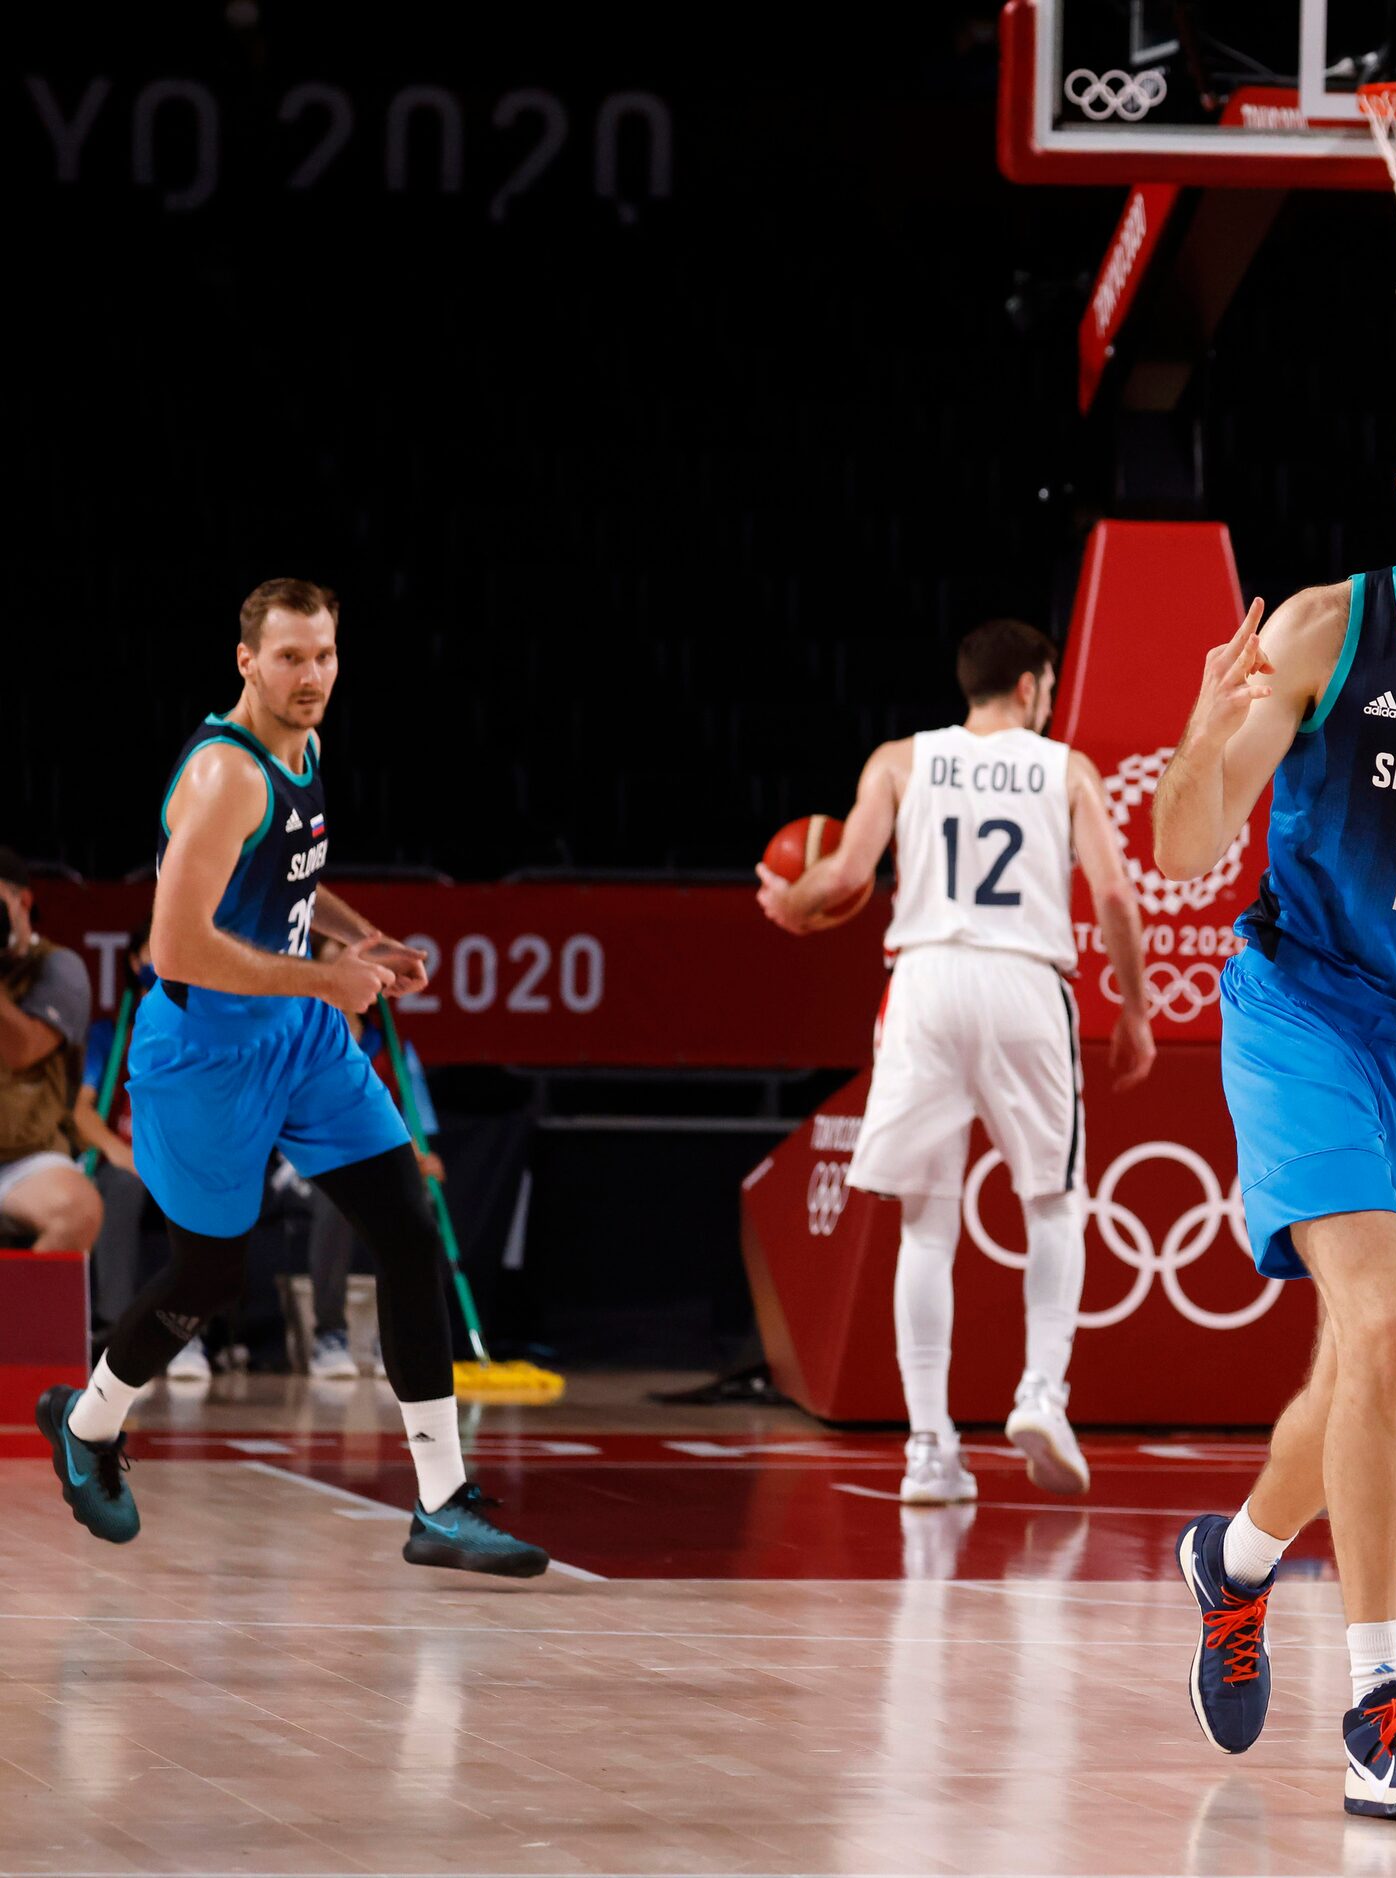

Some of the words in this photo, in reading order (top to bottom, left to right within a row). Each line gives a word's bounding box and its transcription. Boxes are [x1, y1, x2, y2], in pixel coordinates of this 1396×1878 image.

[276, 81, 674, 224] 2020
[931, 756, 963, 788] DE
[973, 762, 1045, 793] COLO
[942, 817, 1024, 906] 12
[396, 933, 605, 1014] 2020
